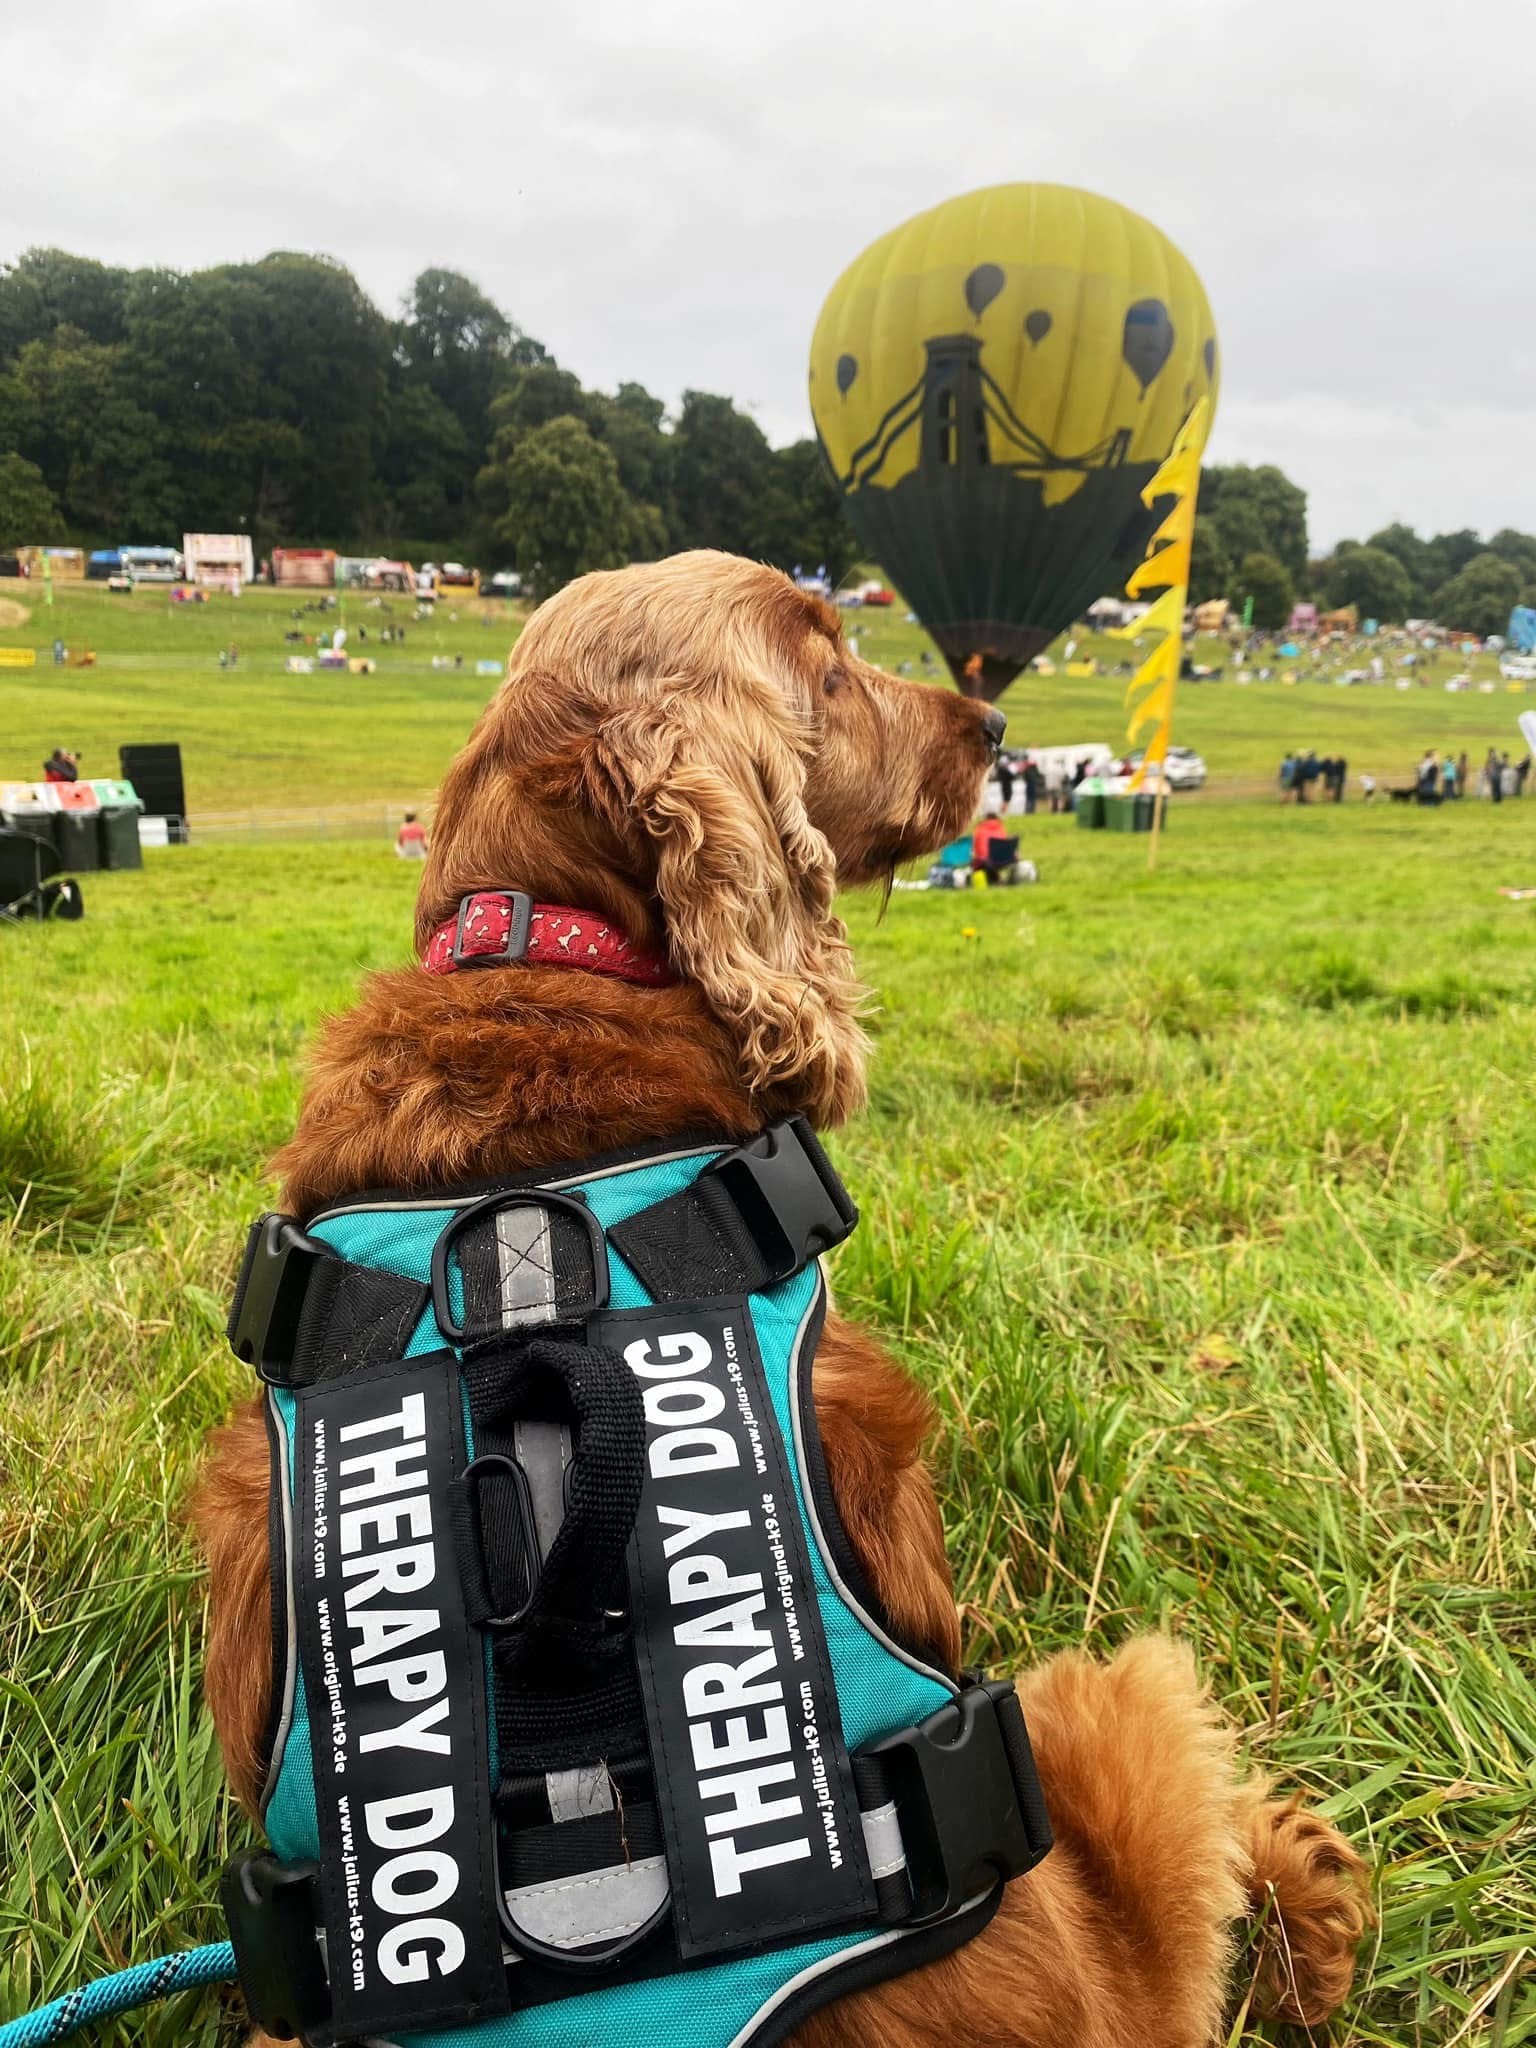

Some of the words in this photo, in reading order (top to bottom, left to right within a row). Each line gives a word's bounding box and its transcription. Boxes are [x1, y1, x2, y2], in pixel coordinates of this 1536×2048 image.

[623, 1332, 740, 1479] DOG
[723, 1327, 768, 1475] www.julius-k9.com
[311, 1419, 329, 1579] www.julius-k9.com
[340, 1392, 451, 1755] THERAPY
[761, 1494, 805, 1661] www.original-k9.de
[318, 1598, 347, 1774] www.original-k9.de
[656, 1505, 811, 1899] THERAPY
[800, 1681, 842, 1869] www.julius-k9.com
[338, 1796, 364, 1991] www.julius-k9.com
[364, 1786, 466, 1985] DOG
